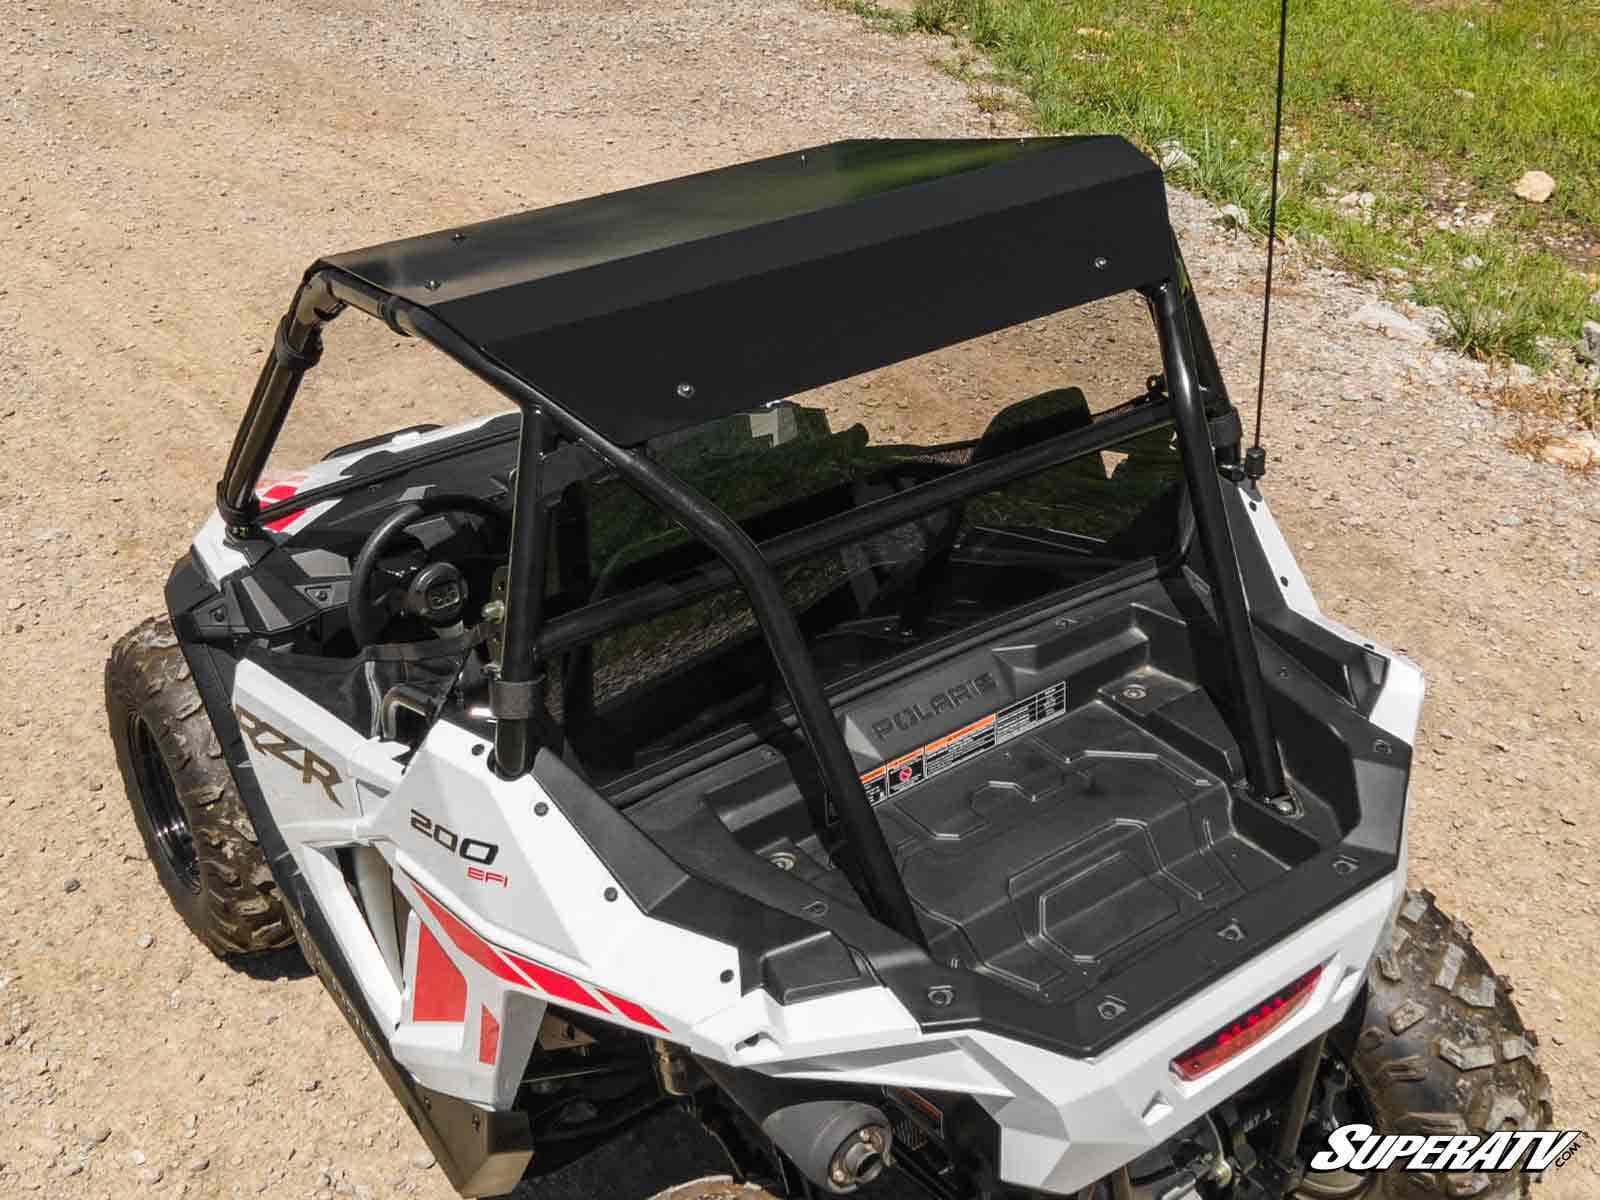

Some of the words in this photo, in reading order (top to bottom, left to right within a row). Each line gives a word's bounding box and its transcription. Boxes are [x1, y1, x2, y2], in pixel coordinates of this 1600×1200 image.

[871, 671, 999, 744] POLARIS
[233, 703, 344, 808] RZR
[410, 808, 499, 866] 200
[467, 866, 509, 888] EFI
